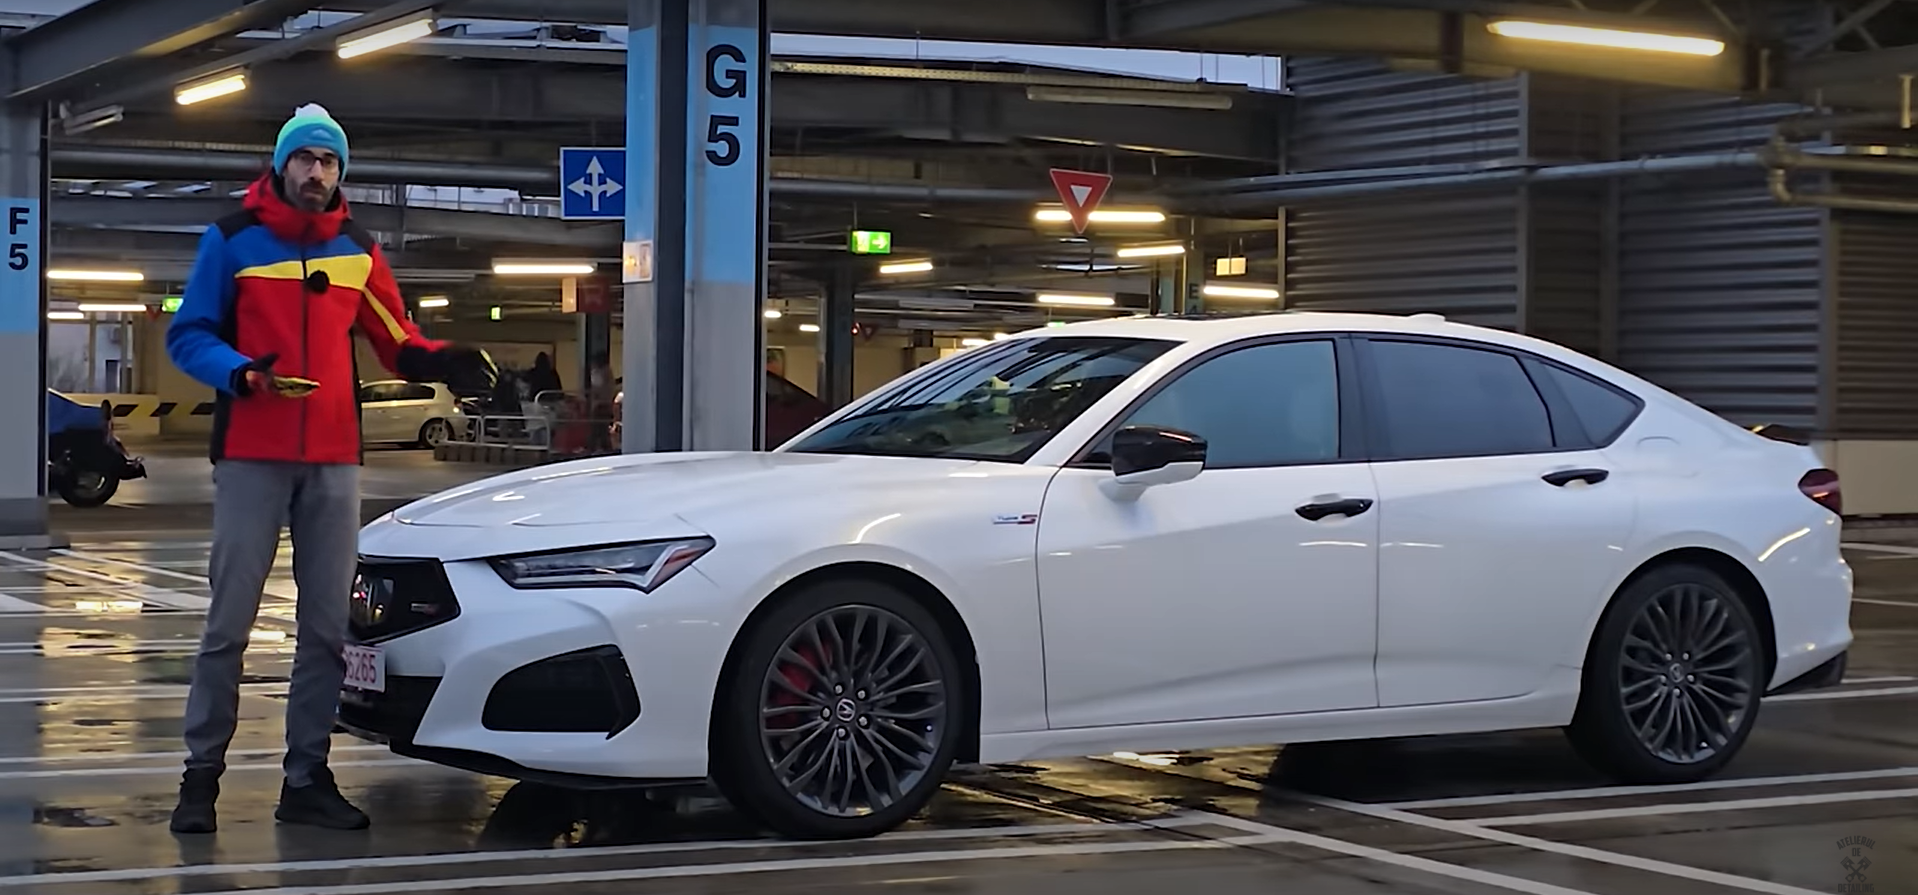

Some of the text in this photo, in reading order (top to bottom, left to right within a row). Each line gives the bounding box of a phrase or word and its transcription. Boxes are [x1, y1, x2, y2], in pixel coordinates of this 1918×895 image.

[706, 44, 746, 98] G
[705, 115, 741, 166] 5
[9, 207, 30, 235] F
[8, 243, 29, 270] 5
[1189, 283, 1199, 299] E
[345, 651, 377, 683] 6265
